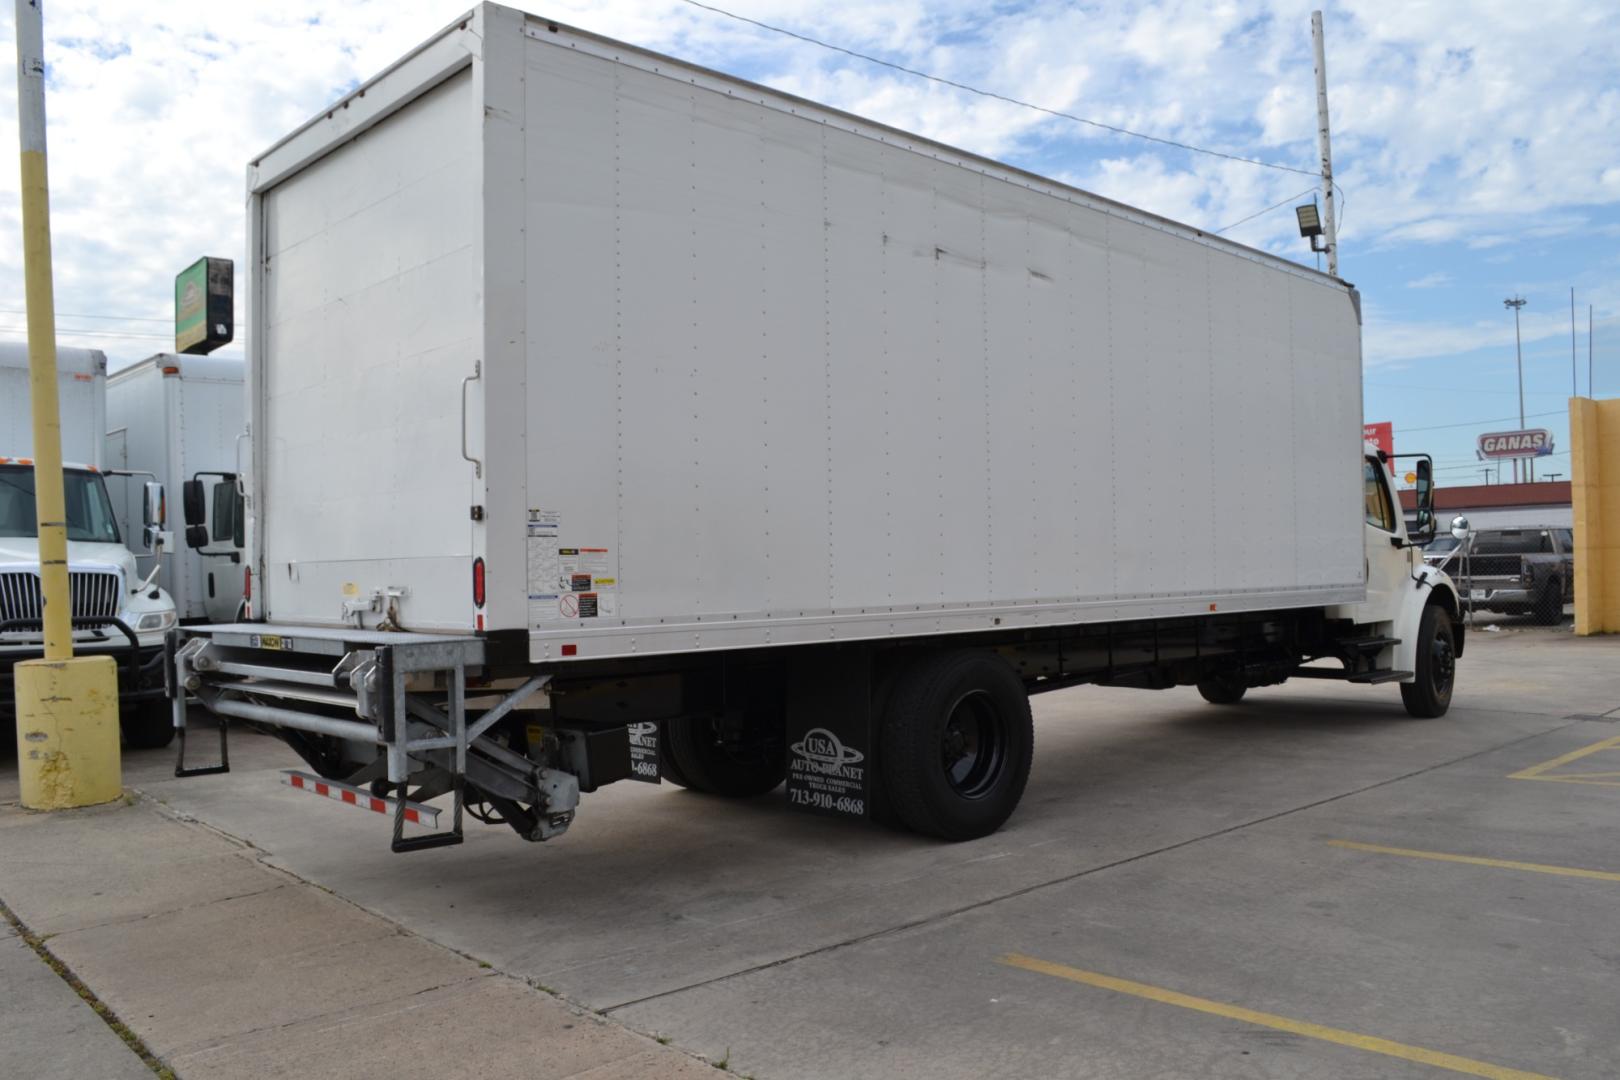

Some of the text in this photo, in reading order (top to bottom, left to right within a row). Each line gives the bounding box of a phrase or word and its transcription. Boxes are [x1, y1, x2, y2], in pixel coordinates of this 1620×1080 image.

[1484, 434, 1545, 452] GANAS
[808, 738, 835, 755] USA
[790, 758, 818, 773] AUTO
[826, 777, 863, 790] COMMERCIAL
[790, 788, 864, 815] 713-910-6868
